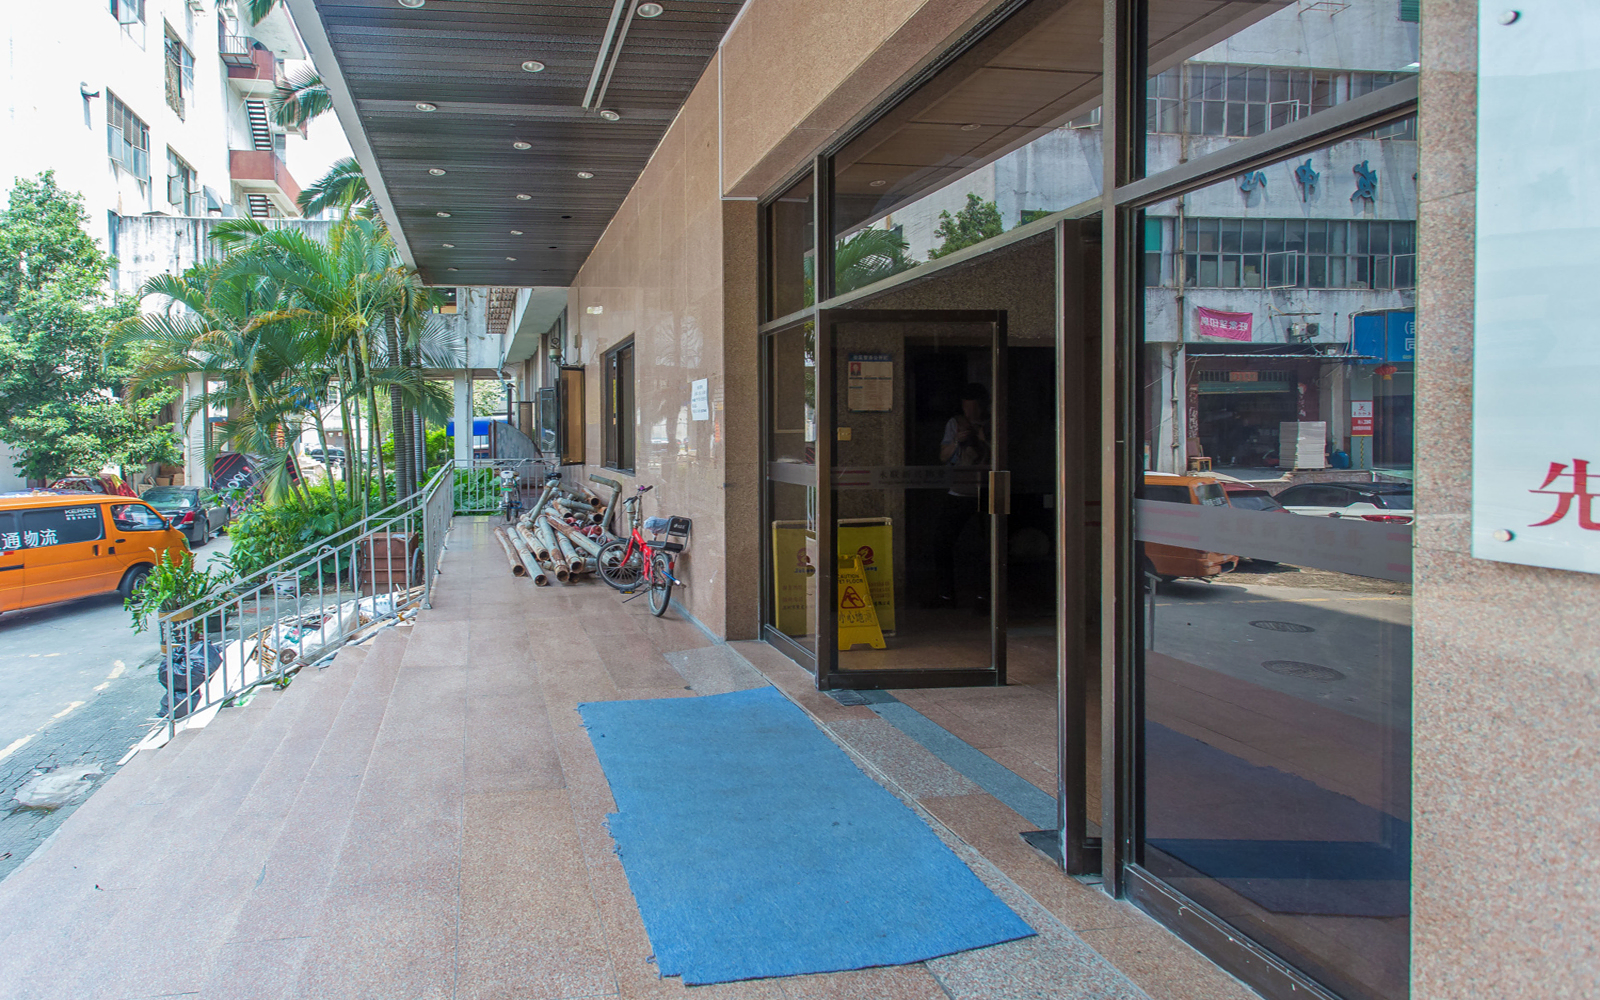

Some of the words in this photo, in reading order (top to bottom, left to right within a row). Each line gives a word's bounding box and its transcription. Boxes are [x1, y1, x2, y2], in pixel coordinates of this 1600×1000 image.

[1527, 458, 1600, 531] 先
[1, 528, 59, 550] 通物流
